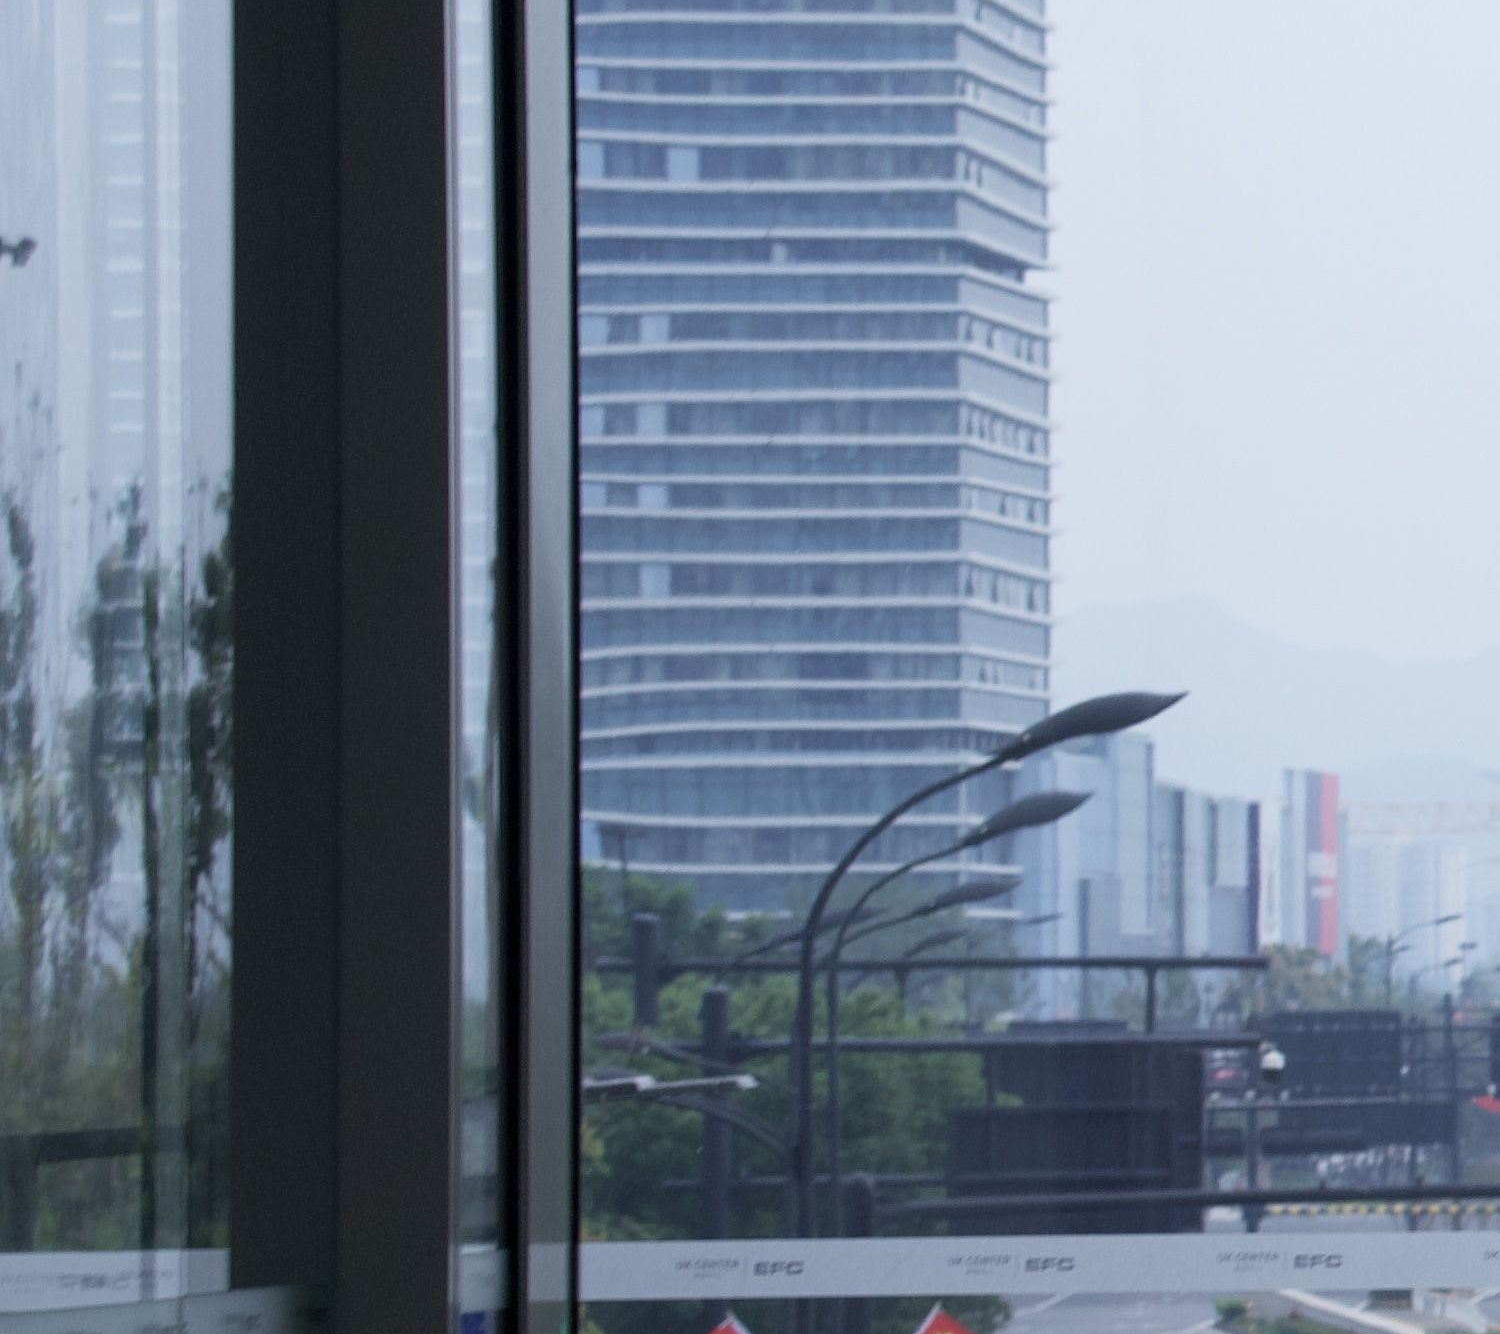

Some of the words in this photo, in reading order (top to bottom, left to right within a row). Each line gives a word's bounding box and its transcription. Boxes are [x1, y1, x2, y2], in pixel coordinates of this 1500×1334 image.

[753, 1260, 804, 1276] EFC
[1024, 1257, 1075, 1272] EFC
[1293, 1254, 1343, 1269] EFC
